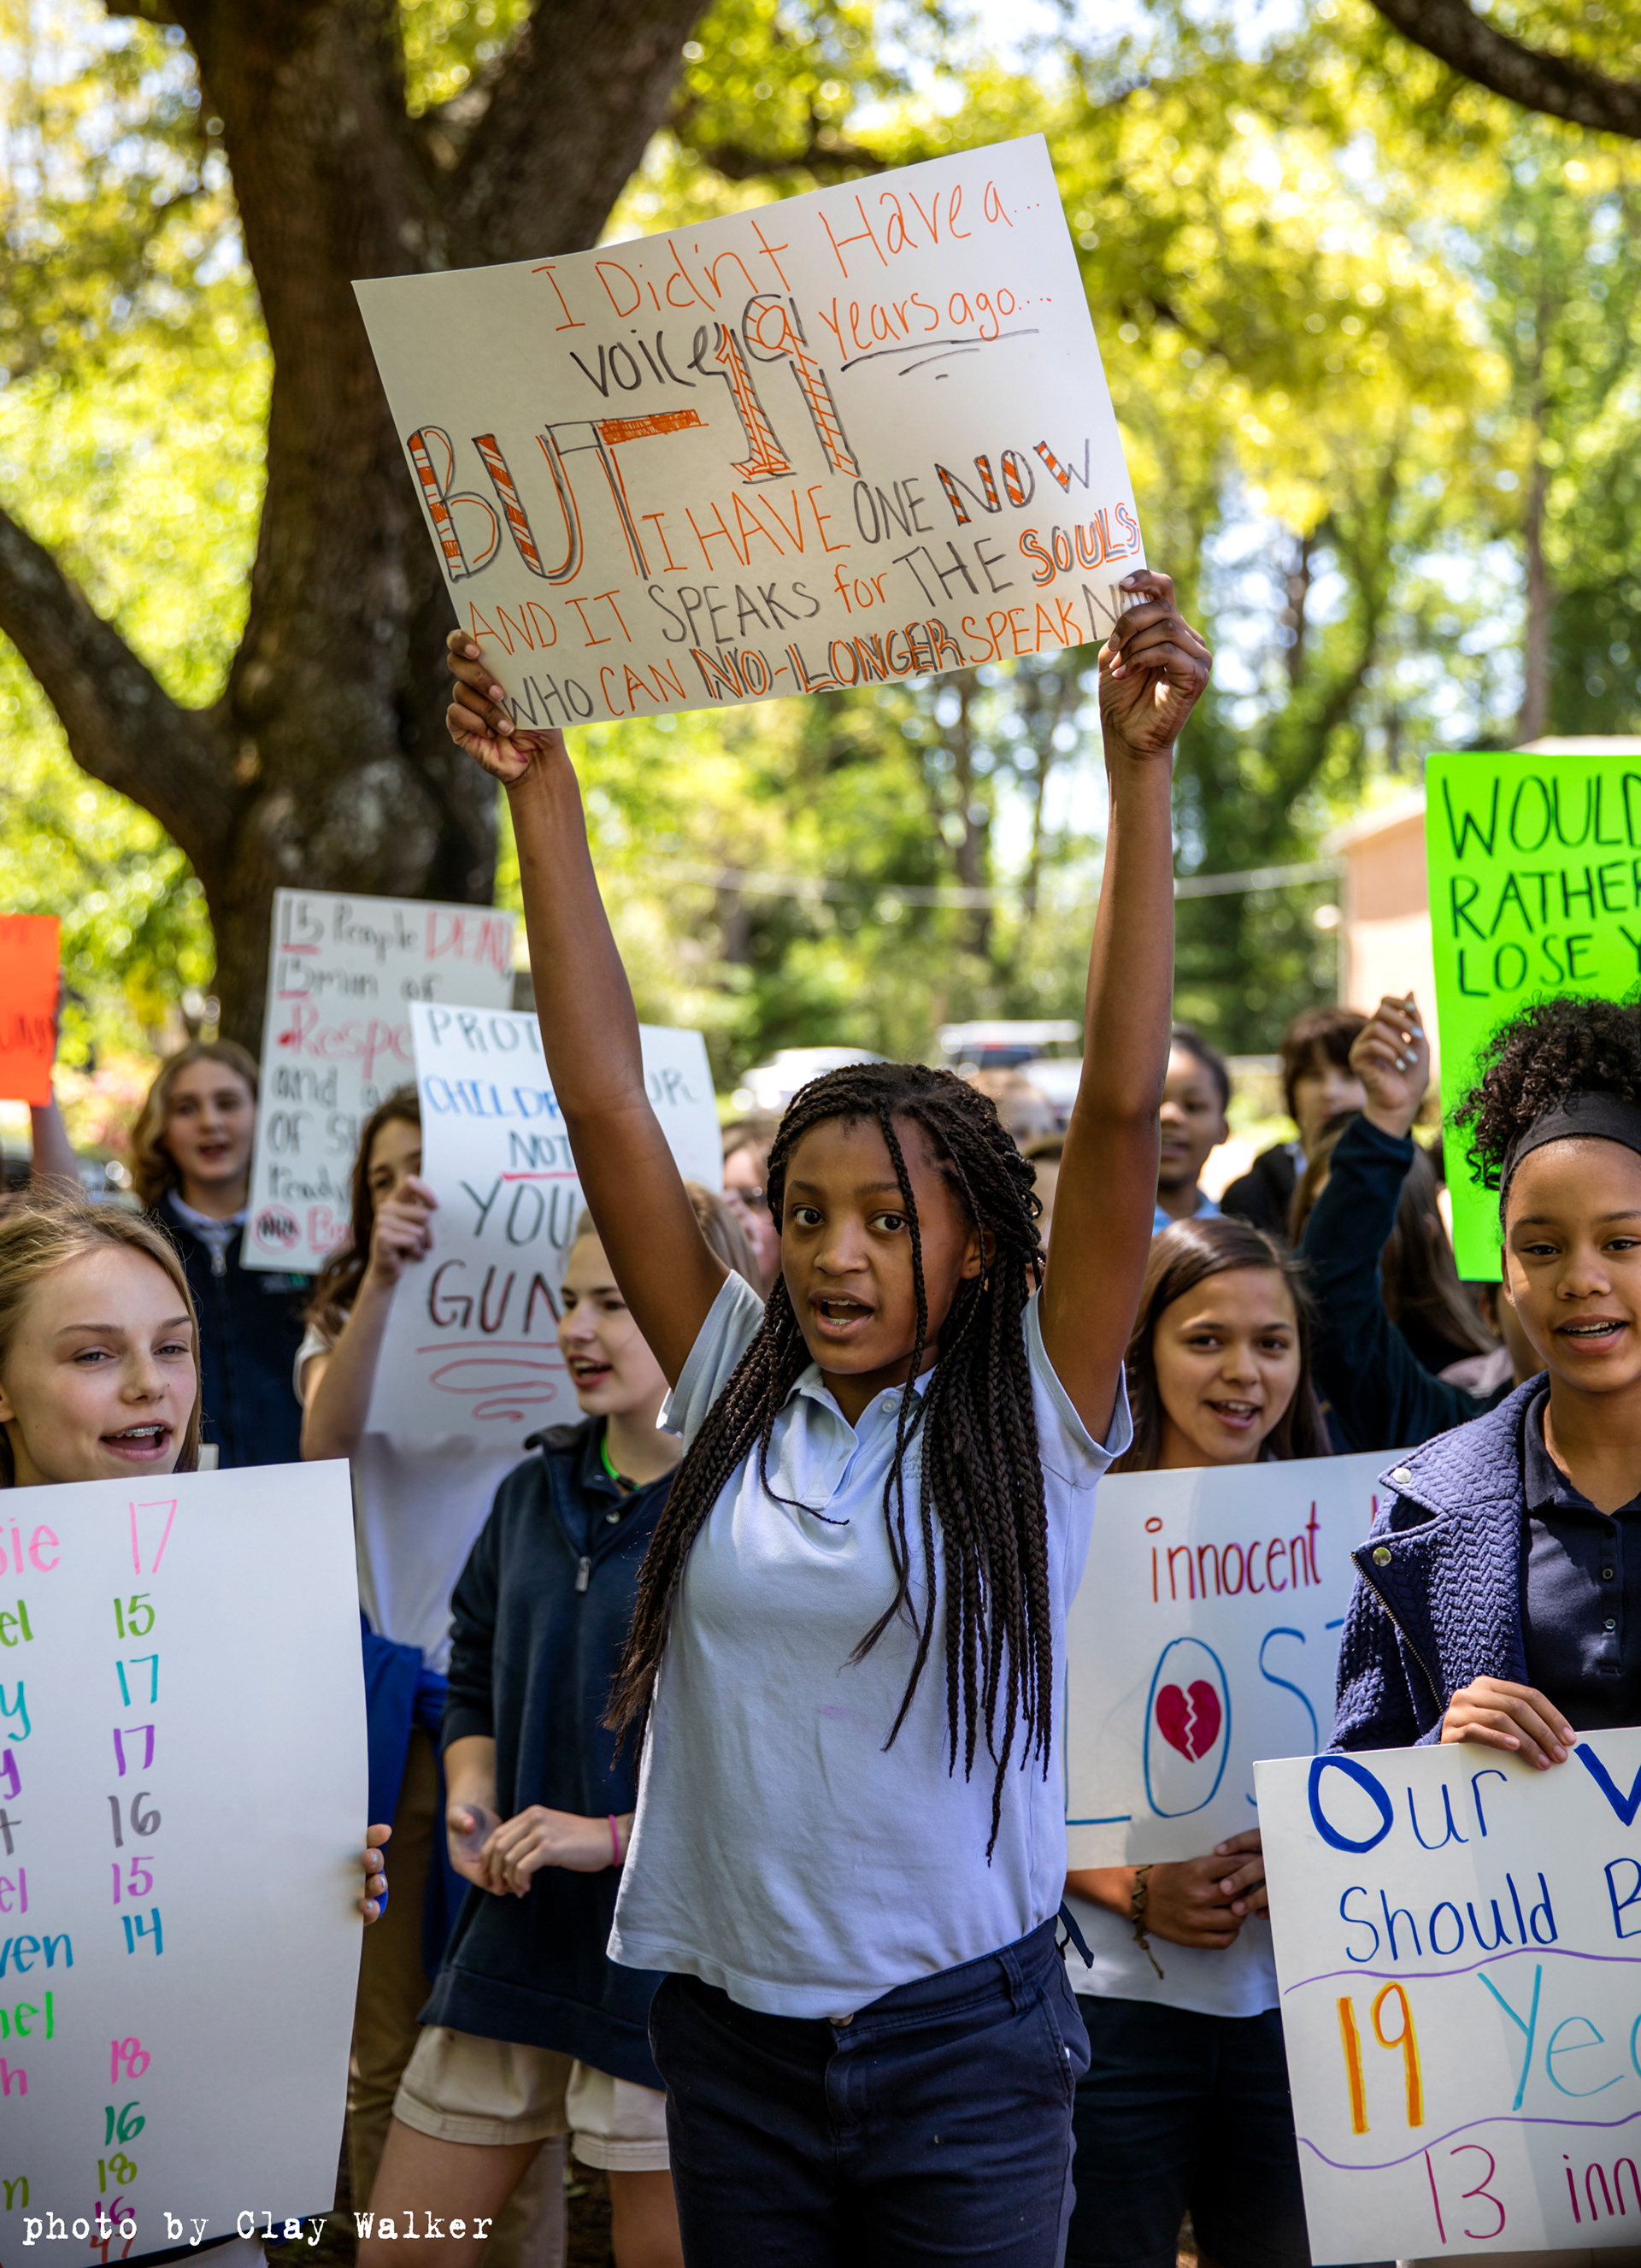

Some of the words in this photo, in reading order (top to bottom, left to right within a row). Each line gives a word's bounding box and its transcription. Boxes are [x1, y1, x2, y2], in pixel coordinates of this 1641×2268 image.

[532, 266, 585, 331] I
[818, 186, 971, 278] Have
[570, 324, 725, 398] voice
[715, 293, 861, 485] 19
[407, 409, 709, 585] BUT
[641, 512, 688, 572] I
[685, 485, 851, 571] HAVE
[853, 477, 934, 545] ONE
[934, 438, 1091, 527] NOW
[468, 600, 558, 656] AND
[564, 590, 632, 647] IT
[647, 581, 821, 648] SPEAKS
[834, 563, 888, 613] for
[891, 537, 1015, 607] THE
[1019, 502, 1141, 587] SOULS
[499, 674, 594, 727] WHO
[600, 658, 686, 716] CAN
[961, 597, 1084, 664] SPEAK
[1458, 934, 1600, 999] LOSE
[270, 1065, 338, 1109] and
[509, 1129, 574, 1171] NOT
[129, 1499, 178, 1576] 17
[1144, 1499, 1322, 1605] innocent
[113, 1593, 156, 1640] 15
[115, 1653, 159, 1707] 17
[113, 1724, 156, 1777] 17
[107, 1791, 162, 1848] 16
[1308, 1754, 1509, 1854] Our
[112, 1855, 155, 1906] 15
[121, 1907, 164, 1957] 14
[1338, 1871, 1559, 1964] Should
[110, 2036, 151, 2084] 18
[1336, 1980, 1426, 2136] 19
[104, 2100, 146, 2147] 16
[97, 2151, 138, 2194] 18
[1424, 2143, 1507, 2246] 13
